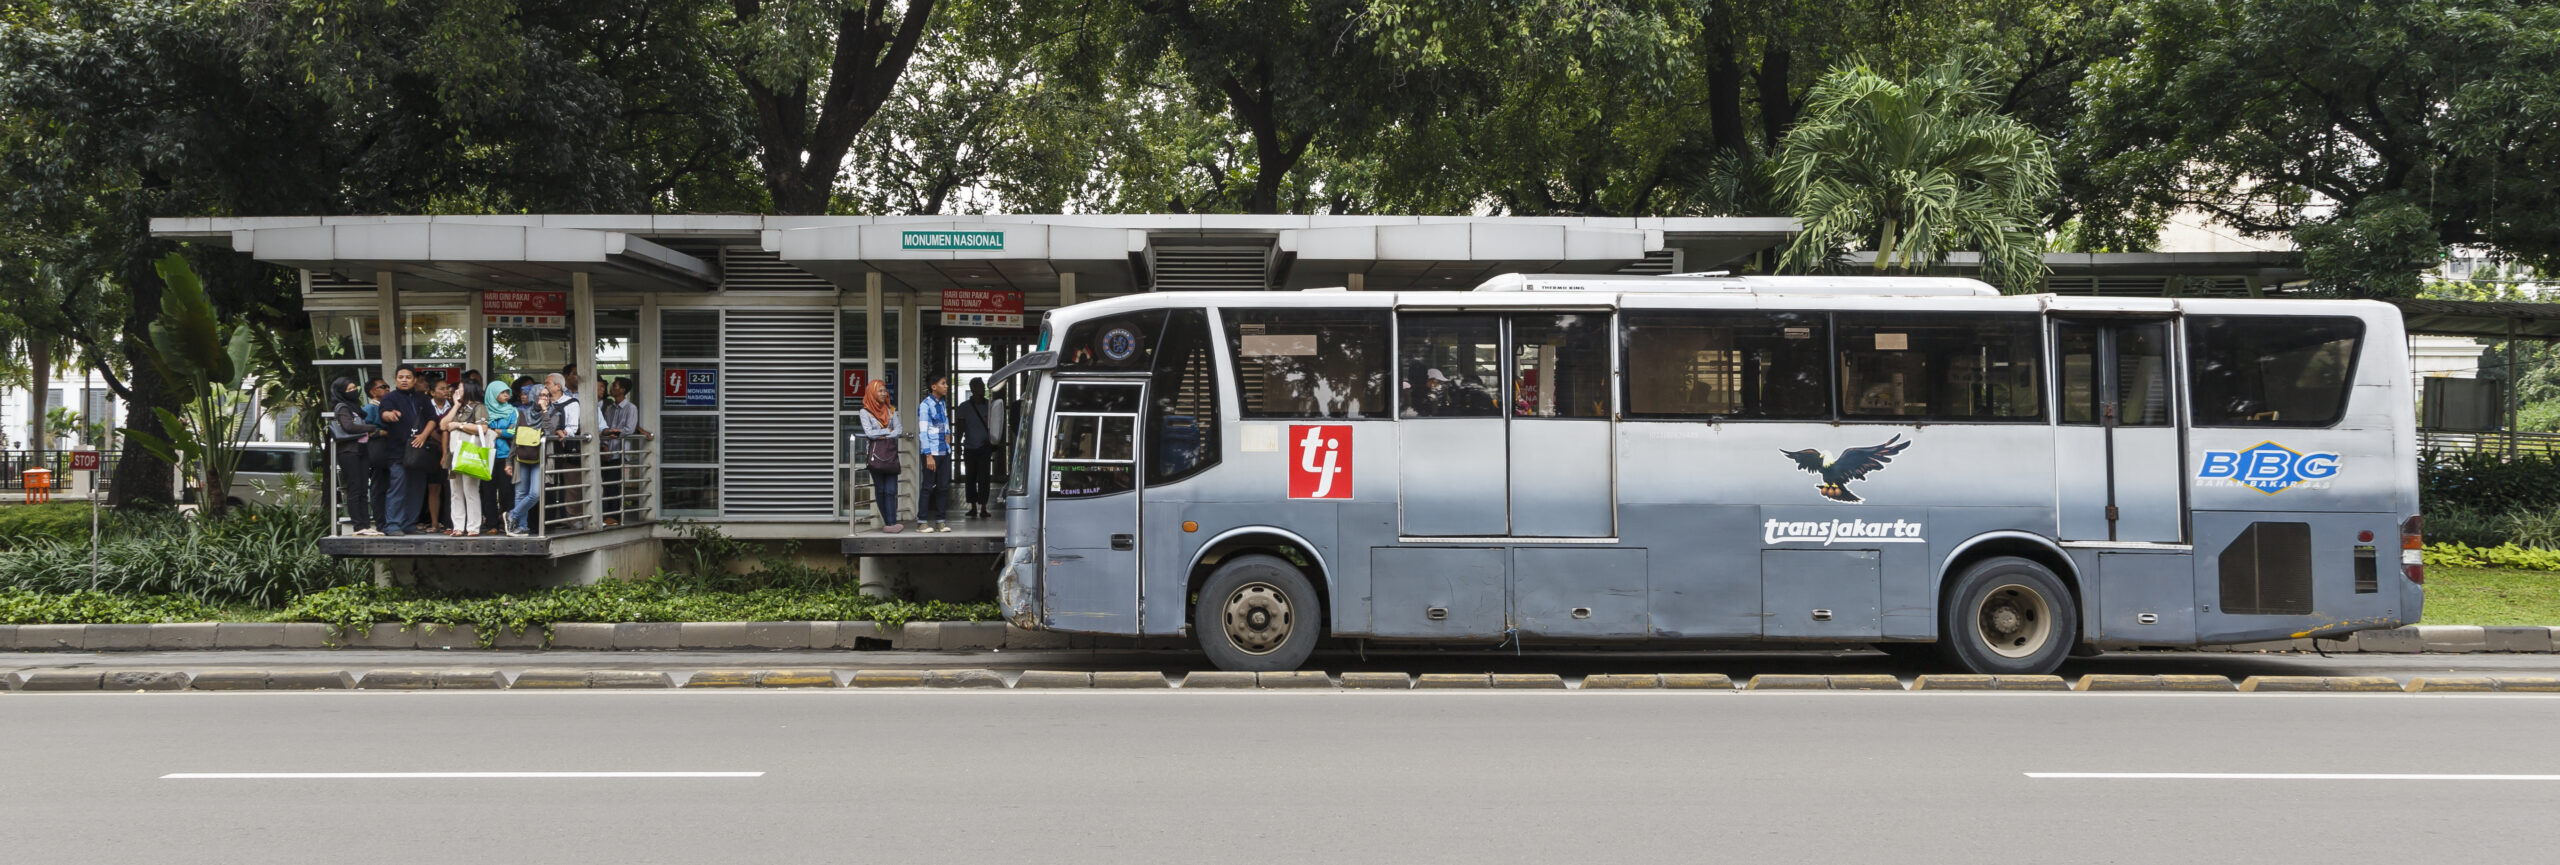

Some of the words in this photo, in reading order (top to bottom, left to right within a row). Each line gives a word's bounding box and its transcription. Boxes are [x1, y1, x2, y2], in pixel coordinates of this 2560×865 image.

[904, 234, 951, 246] MONUMEN
[953, 234, 1002, 247] NASIONAL
[484, 292, 498, 300] HARI
[512, 293, 530, 301] PAKAI
[944, 290, 958, 298] HARI
[959, 291, 970, 299] GINI
[971, 292, 989, 300] PAKAI
[484, 301, 500, 309] UANG
[961, 299, 982, 307] TUNAI?
[670, 372, 682, 394] tj
[692, 374, 711, 382] 2-21
[849, 372, 861, 394] tj
[74, 454, 96, 467] STOP
[1300, 426, 1341, 498] tj
[2195, 449, 2343, 481] BBG
[2249, 480, 2298, 488] BAKAR
[2302, 481, 2331, 489] GAS
[1764, 518, 1926, 547] transjakarta
